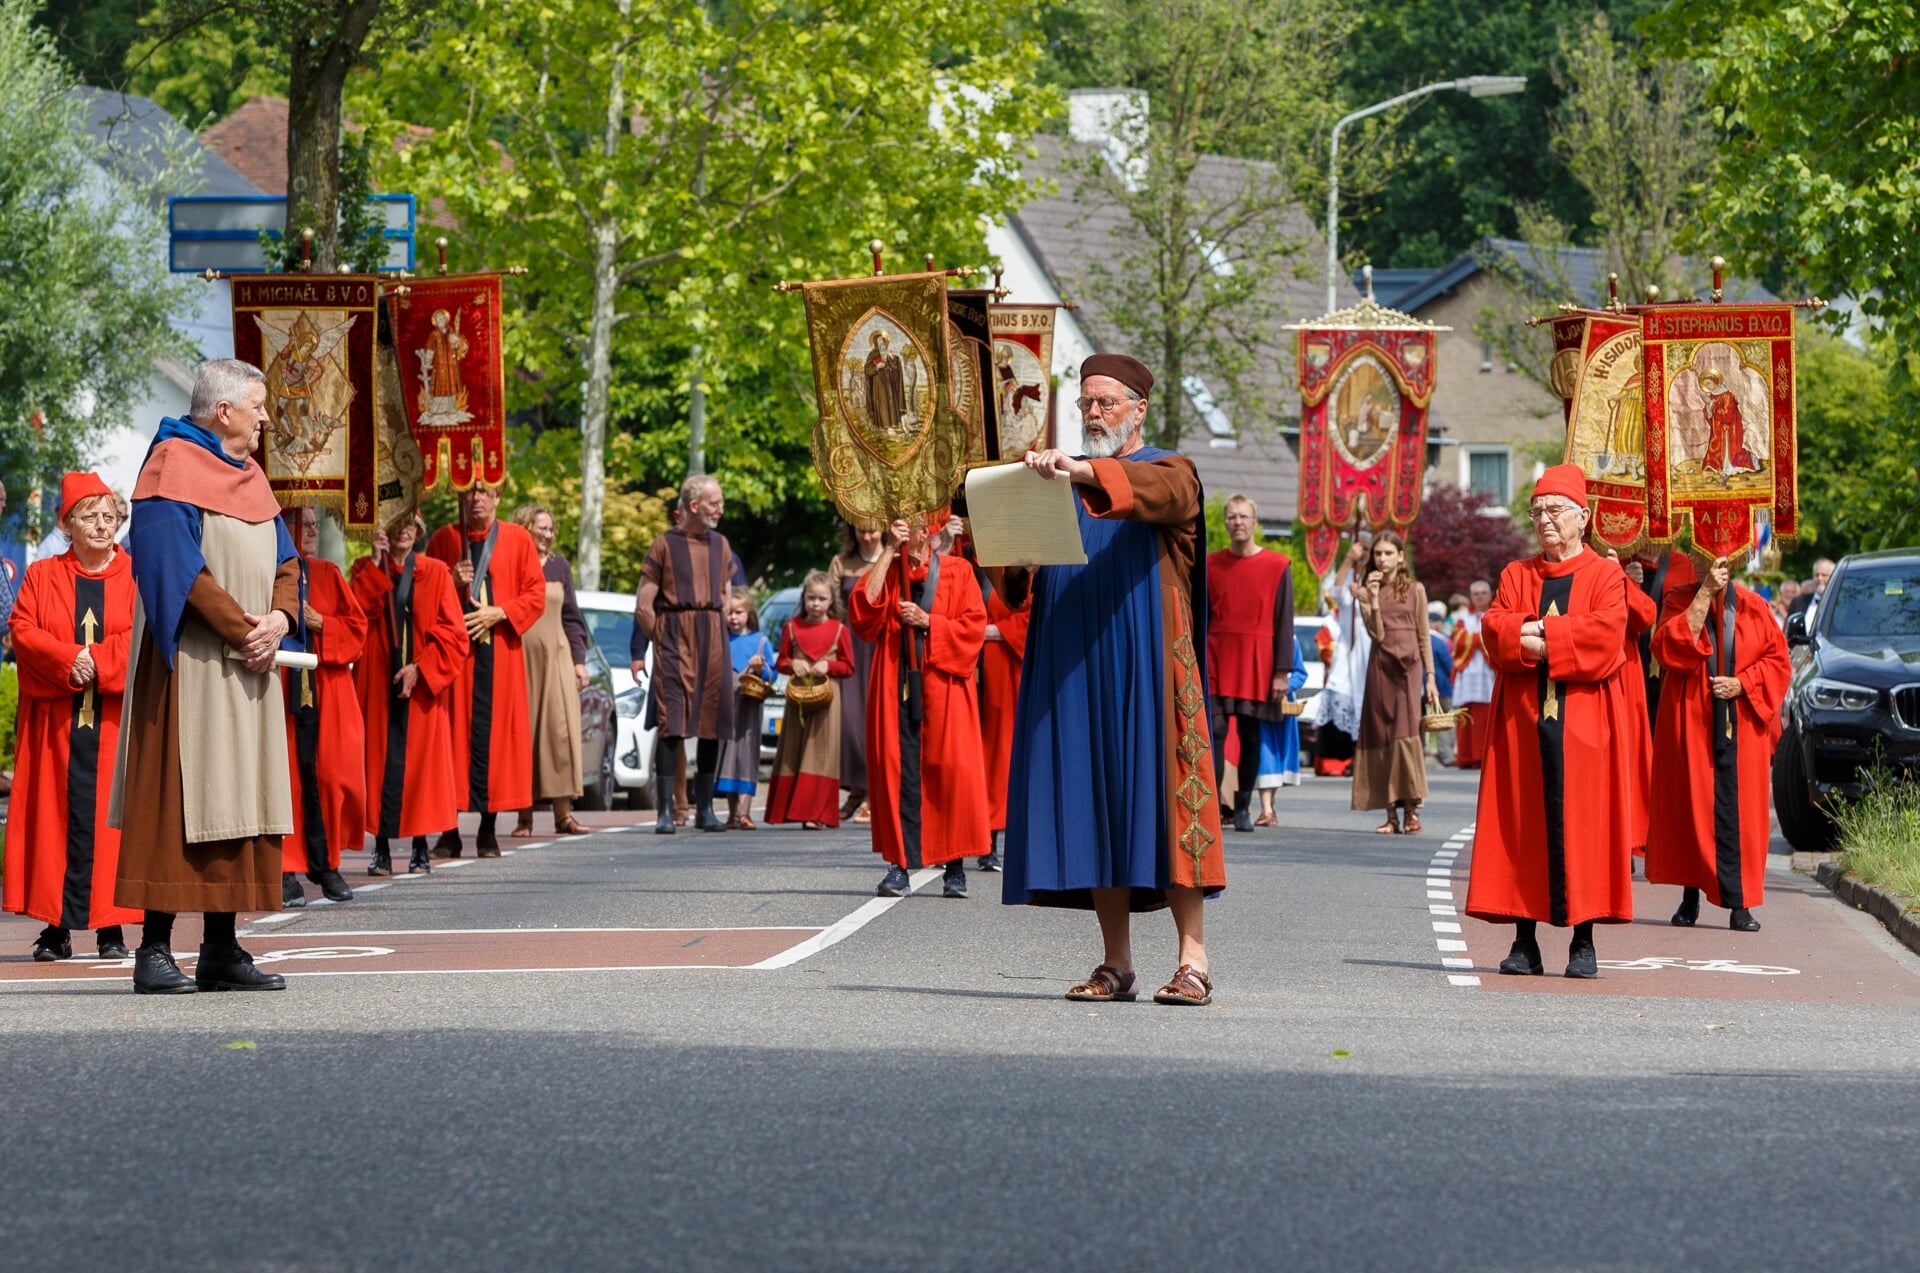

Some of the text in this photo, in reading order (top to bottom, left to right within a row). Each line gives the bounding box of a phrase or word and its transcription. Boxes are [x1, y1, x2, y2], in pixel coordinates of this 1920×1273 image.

[257, 283, 319, 302] MICHAËL
[1022, 313, 1052, 328] B.V.O.
[1663, 316, 1744, 334] STEPHANUS
[1714, 528, 1730, 543] IX
